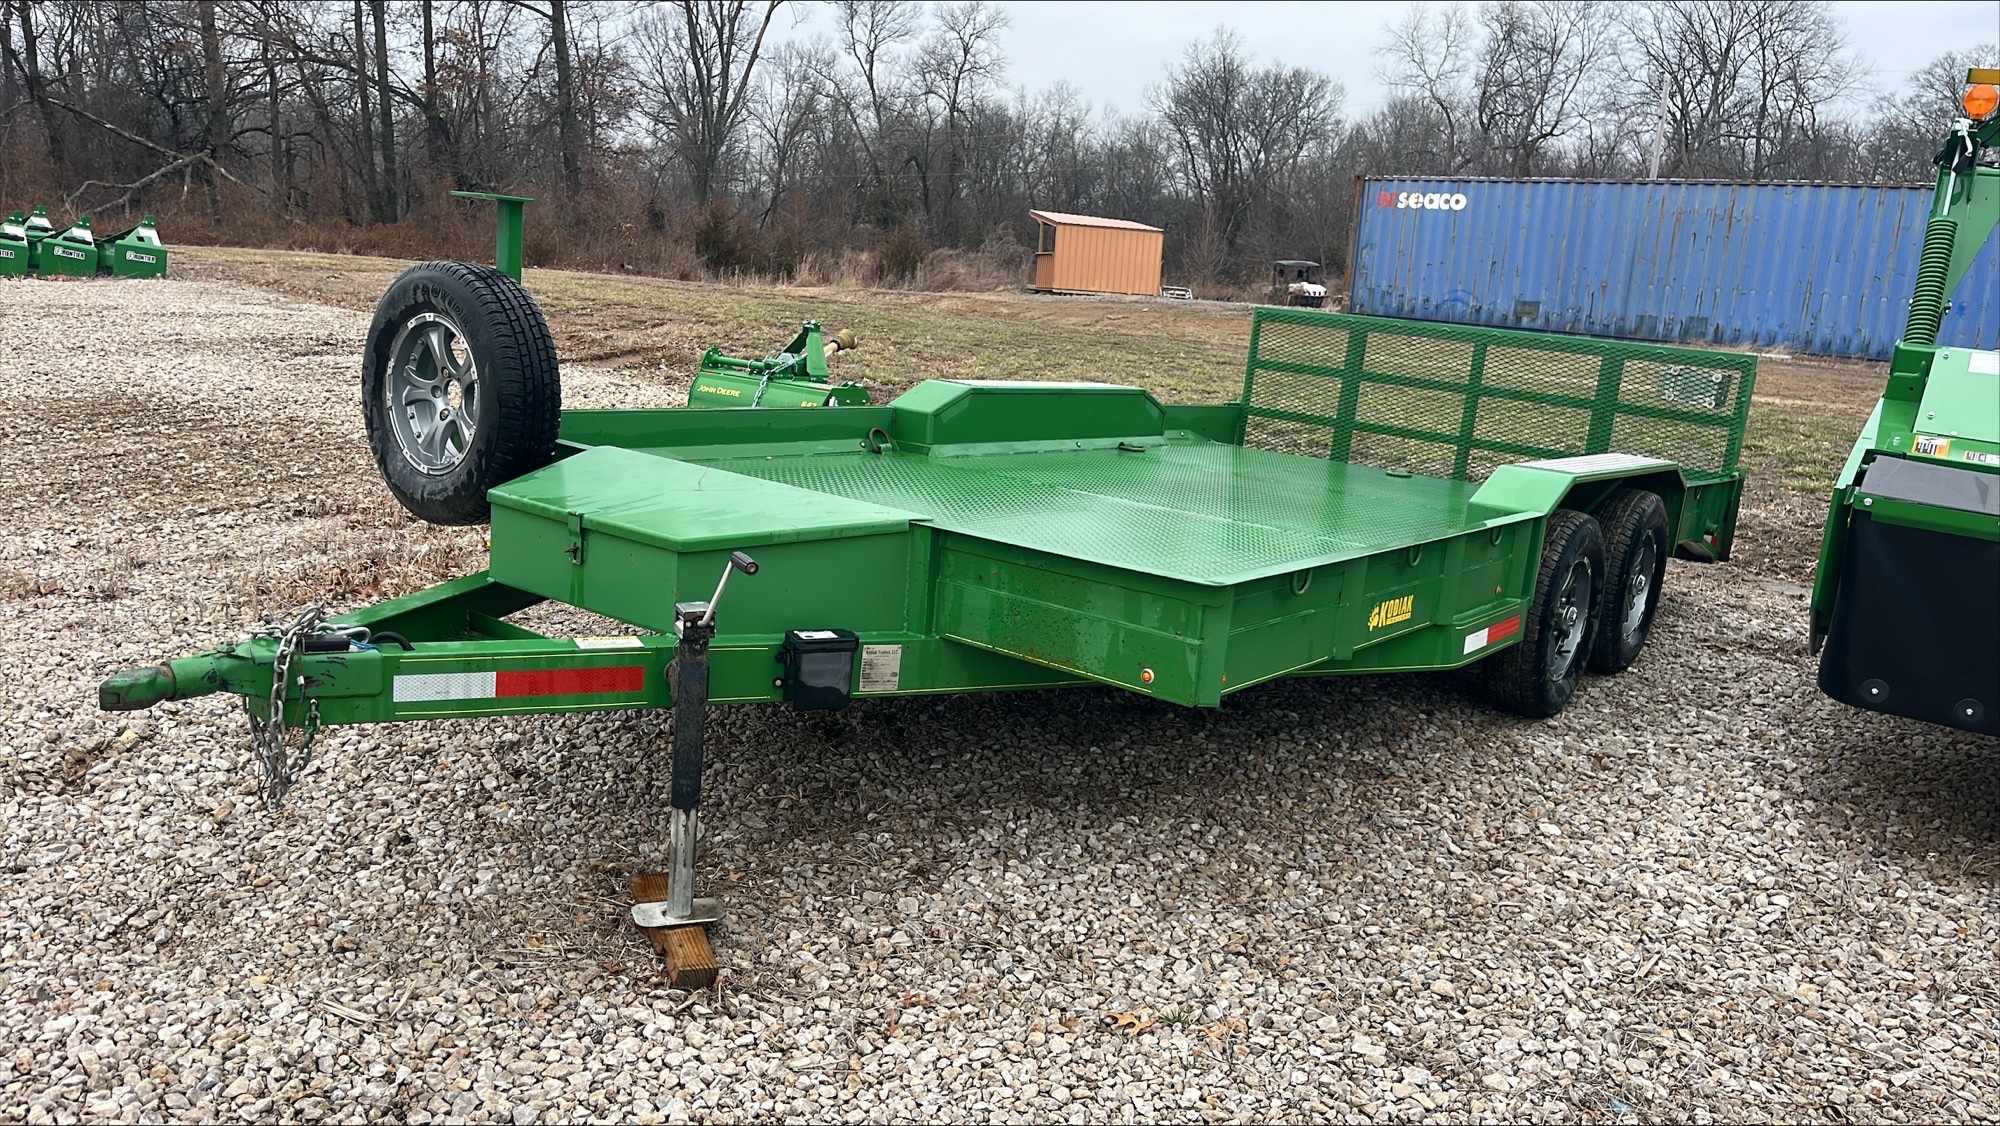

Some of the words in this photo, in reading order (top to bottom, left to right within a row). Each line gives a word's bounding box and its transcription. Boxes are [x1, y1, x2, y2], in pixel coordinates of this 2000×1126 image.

[55, 246, 85, 259] FRONTIER
[697, 384, 716, 394] JOHN
[716, 386, 741, 397] DEERE
[1378, 594, 1414, 628] KODIAK
